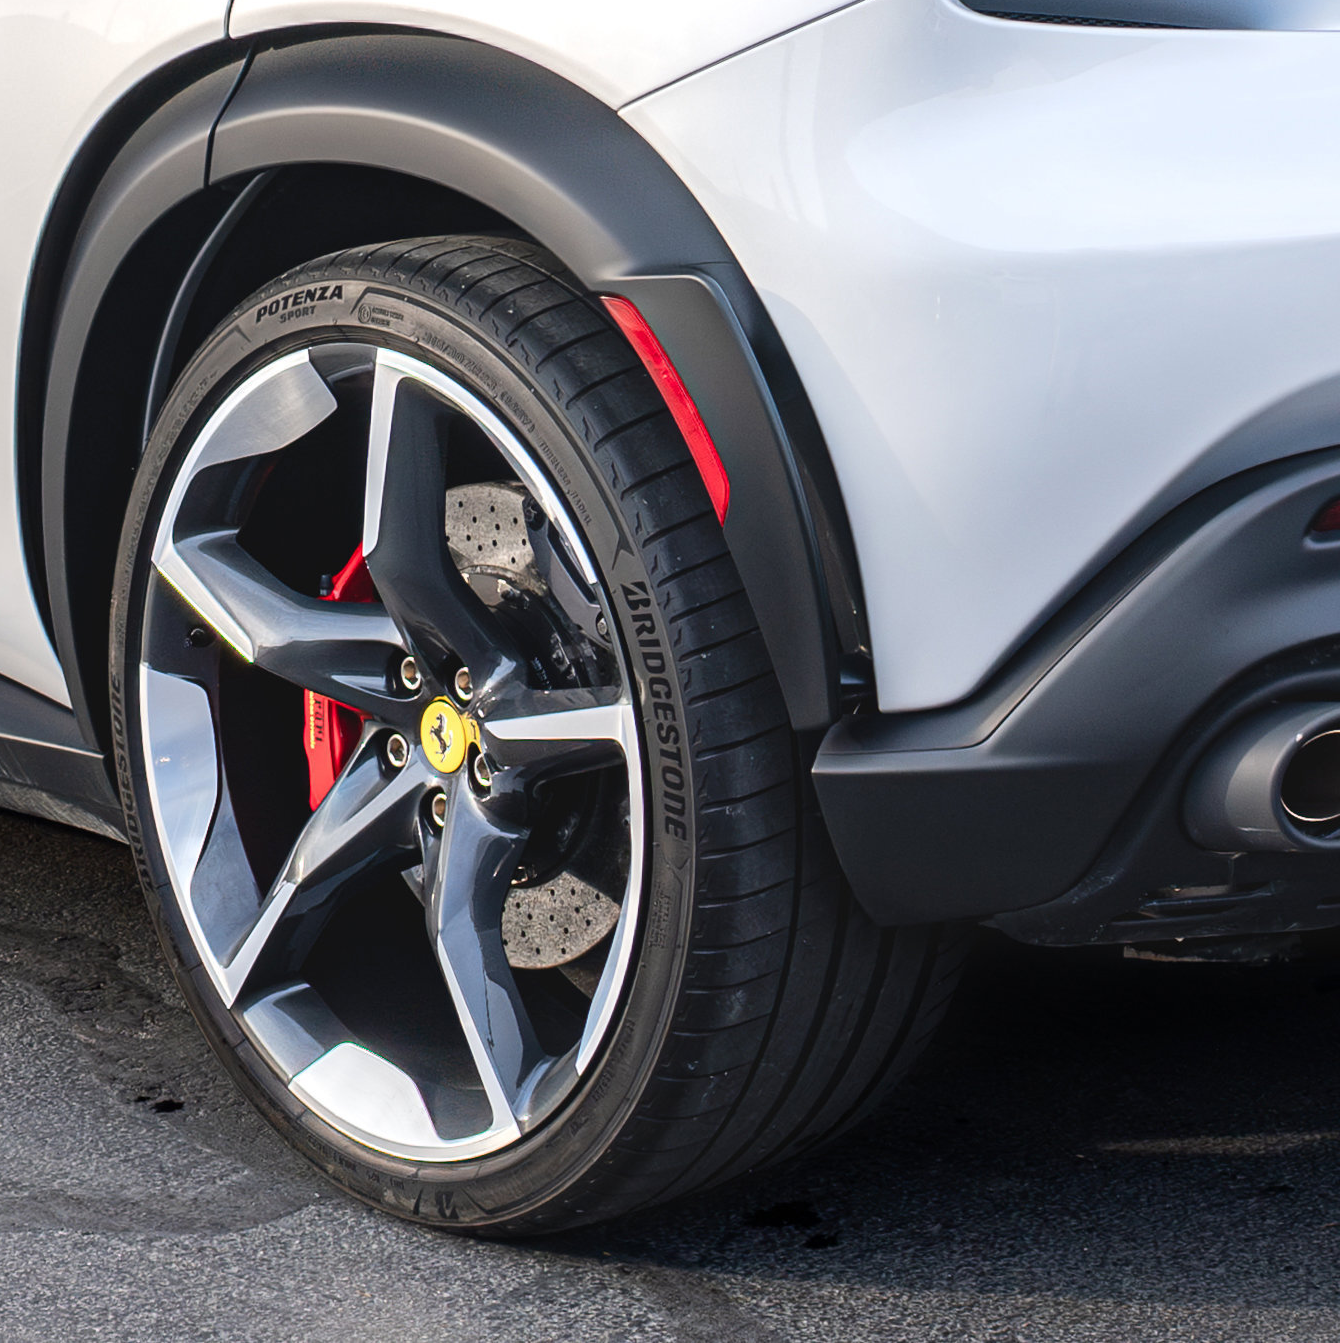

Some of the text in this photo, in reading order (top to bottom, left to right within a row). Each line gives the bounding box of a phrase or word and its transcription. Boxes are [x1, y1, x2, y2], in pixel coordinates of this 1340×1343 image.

[255, 285, 343, 324] POTENZA
[279, 305, 317, 324] SPORT
[620, 581, 687, 842] BRIDGESTONE
